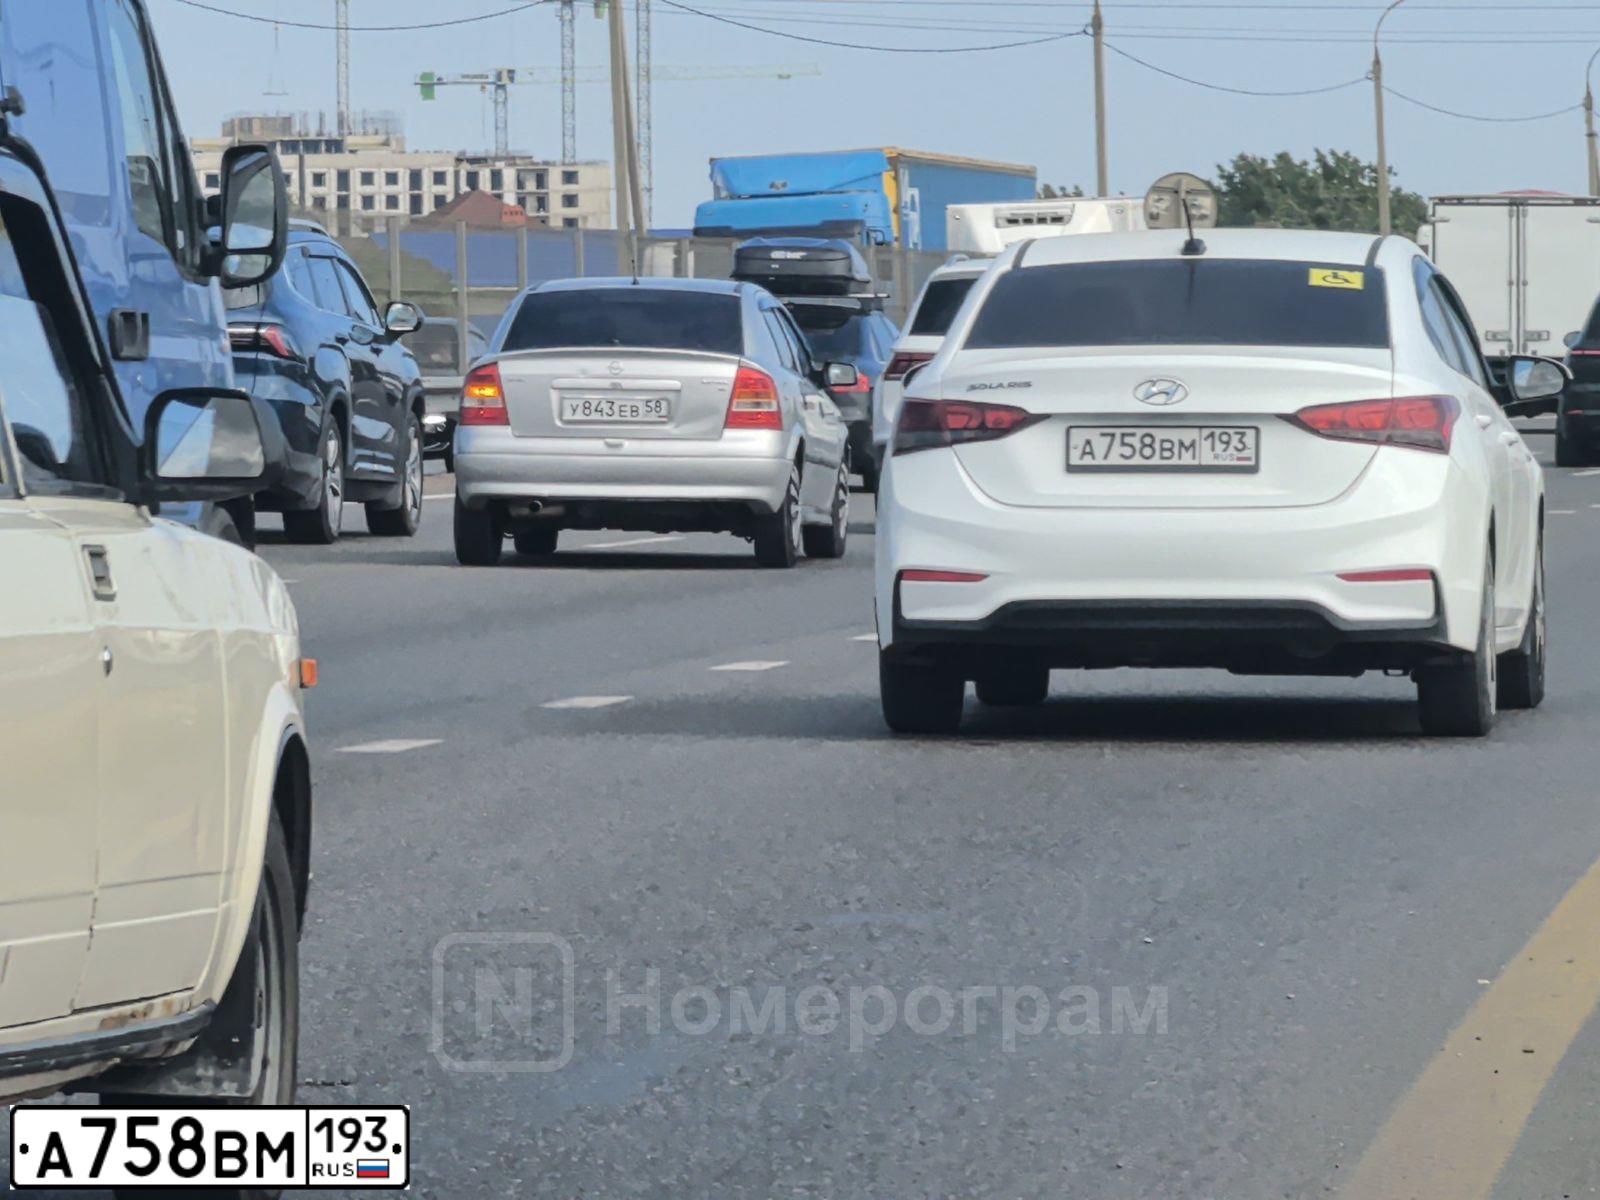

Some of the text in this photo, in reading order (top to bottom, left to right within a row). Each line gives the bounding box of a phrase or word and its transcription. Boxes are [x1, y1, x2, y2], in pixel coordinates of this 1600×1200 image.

[966, 381, 1032, 392] SOLARIS
[570, 399, 662, 418] У843ЕВ 58
[1079, 431, 1247, 461] А758ВМ 193
[1213, 453, 1236, 461] RUS
